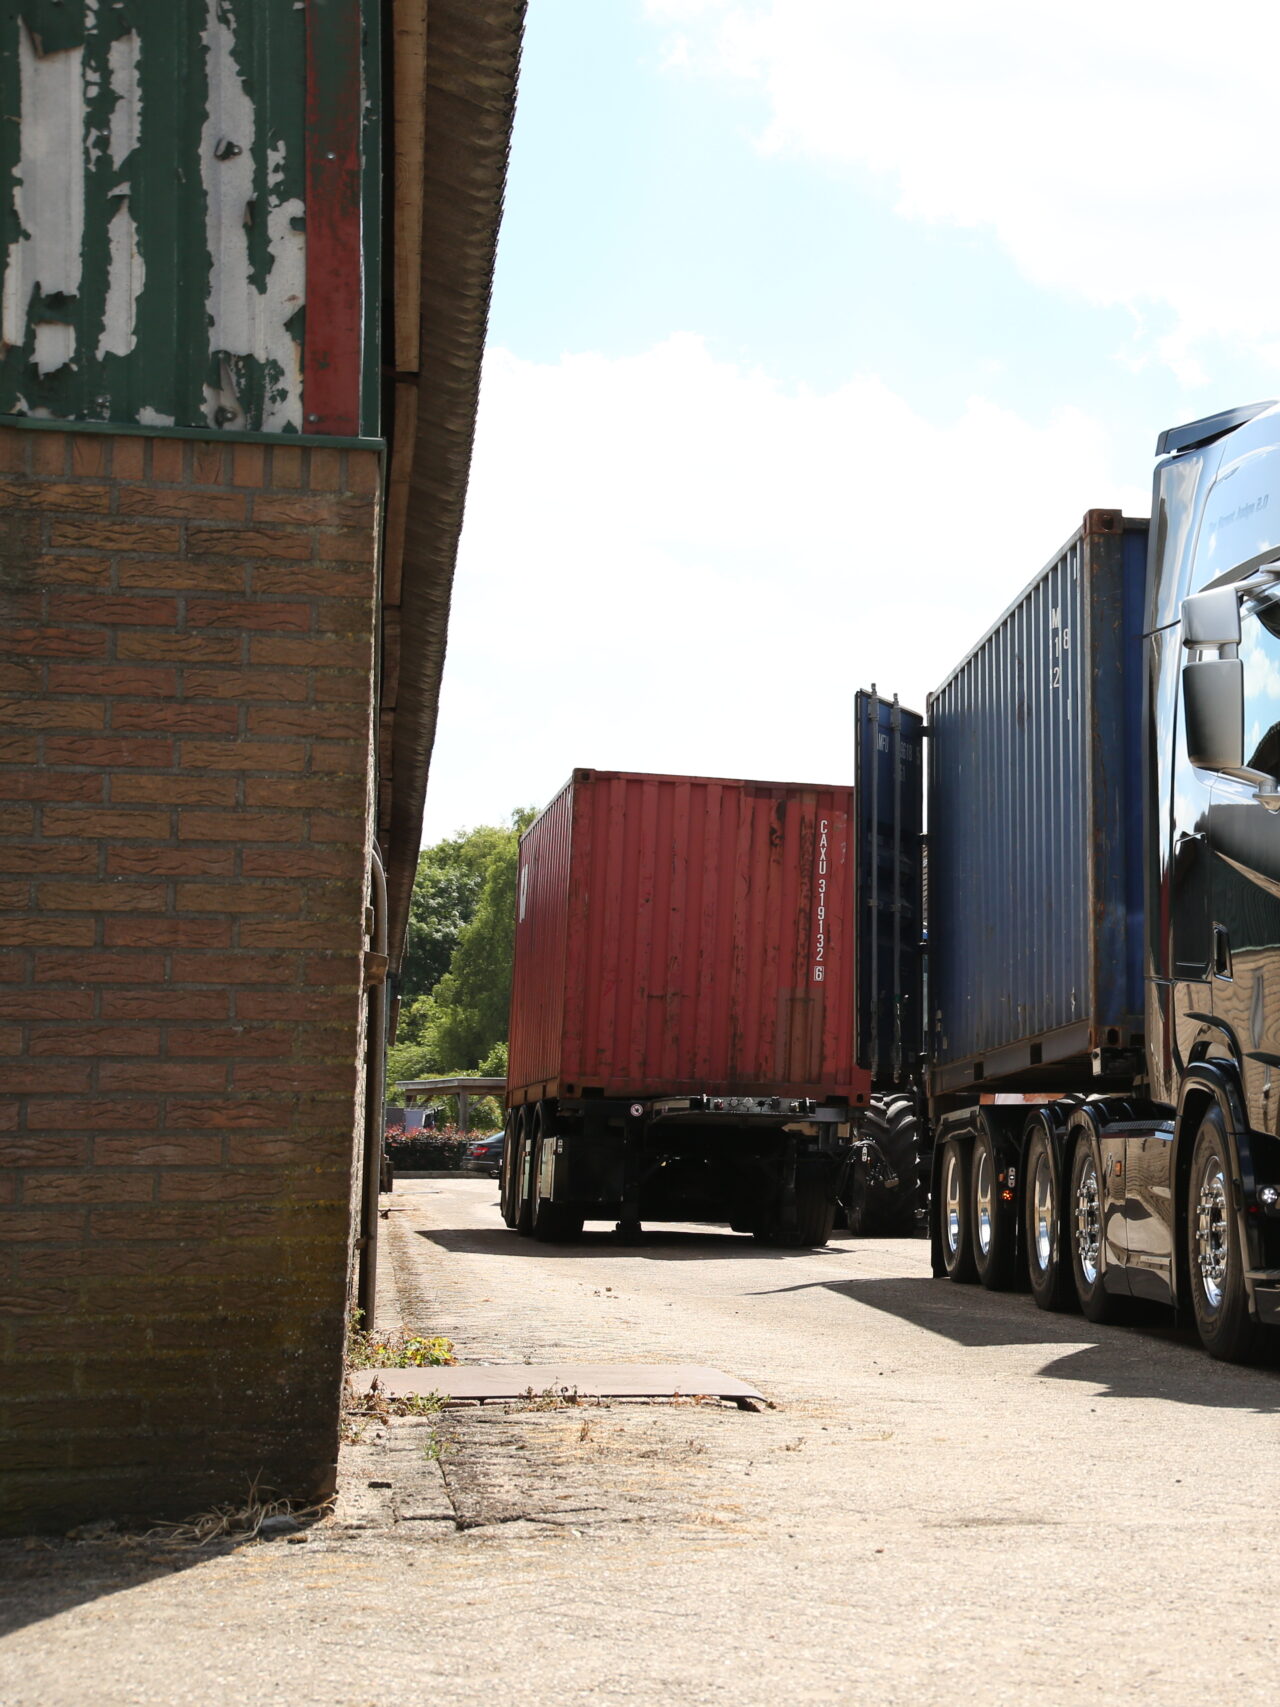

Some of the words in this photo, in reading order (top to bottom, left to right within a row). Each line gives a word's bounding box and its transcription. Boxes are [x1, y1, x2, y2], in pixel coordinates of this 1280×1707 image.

[818, 820, 828, 875] CAXU
[816, 879, 826, 961] 319132
[814, 966, 824, 981] 6
